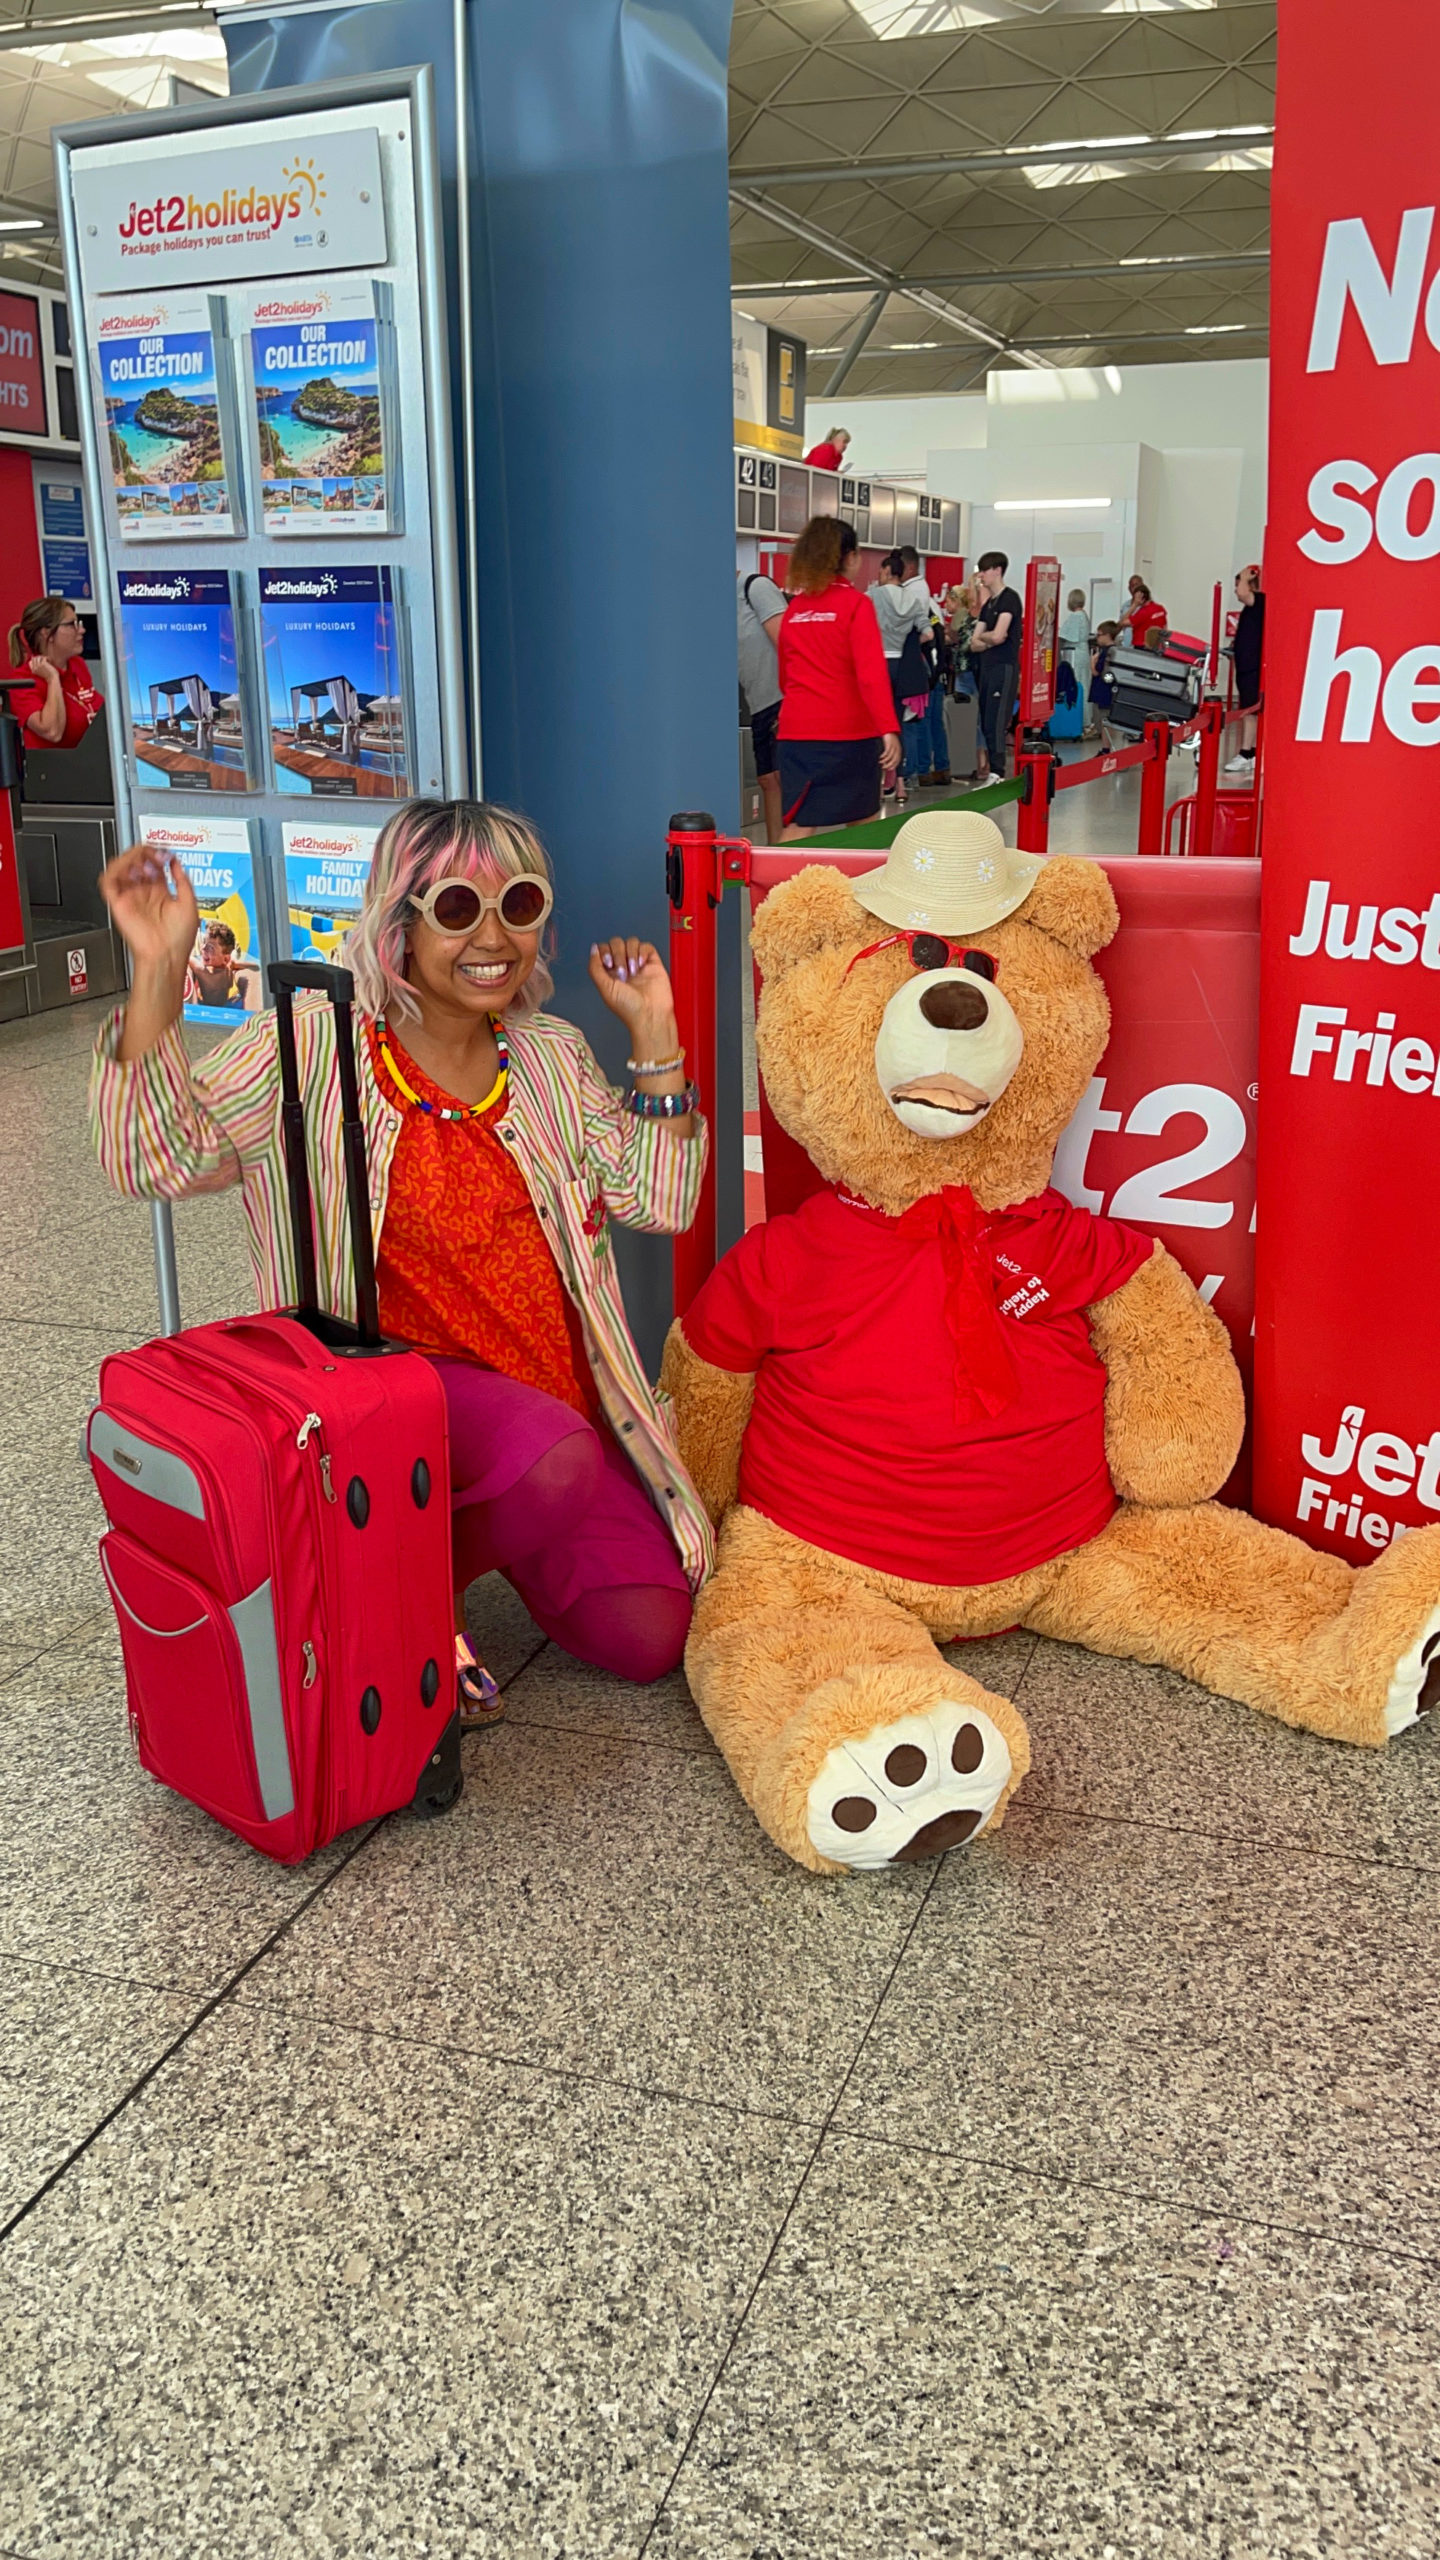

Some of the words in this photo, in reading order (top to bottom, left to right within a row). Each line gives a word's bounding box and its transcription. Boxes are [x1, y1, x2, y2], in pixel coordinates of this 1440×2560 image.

[119, 186, 301, 238] Jet2holidays
[121, 242, 161, 256] Package
[163, 237, 204, 252] holidays
[206, 236, 223, 250] you
[226, 233, 244, 244] can
[246, 228, 271, 241] trust
[1306, 205, 1440, 374] N
[254, 299, 323, 318] Jet2holidays
[99, 314, 160, 331] Jet2holidays
[301, 324, 326, 343] OUR
[139, 337, 164, 355] OUR
[265, 340, 366, 370] COLLECTION
[110, 352, 204, 382] COLLECTION
[741, 458, 753, 484] 42
[123, 582, 182, 600] Jet2holidays
[264, 580, 329, 598] Jet2holidays
[143, 623, 168, 632] LUXURY
[170, 623, 207, 632] HOLIDAYS
[285, 622, 313, 631] LUXURY
[315, 622, 356, 631] HOLIDAYS
[146, 828, 204, 846] Jet2holidays
[290, 836, 353, 855] Jet2holidays
[321, 860, 363, 877] FAMILY
[306, 874, 366, 898] HOLIDA
[1290, 1003, 1440, 1098] Frie
[1050, 1076, 1256, 1229] t2
[996, 1253, 1022, 1275] Jet2
[1027, 1276, 1042, 1289] to
[999, 1287, 1030, 1316] Help!
[1014, 1287, 1050, 1319] Happy
